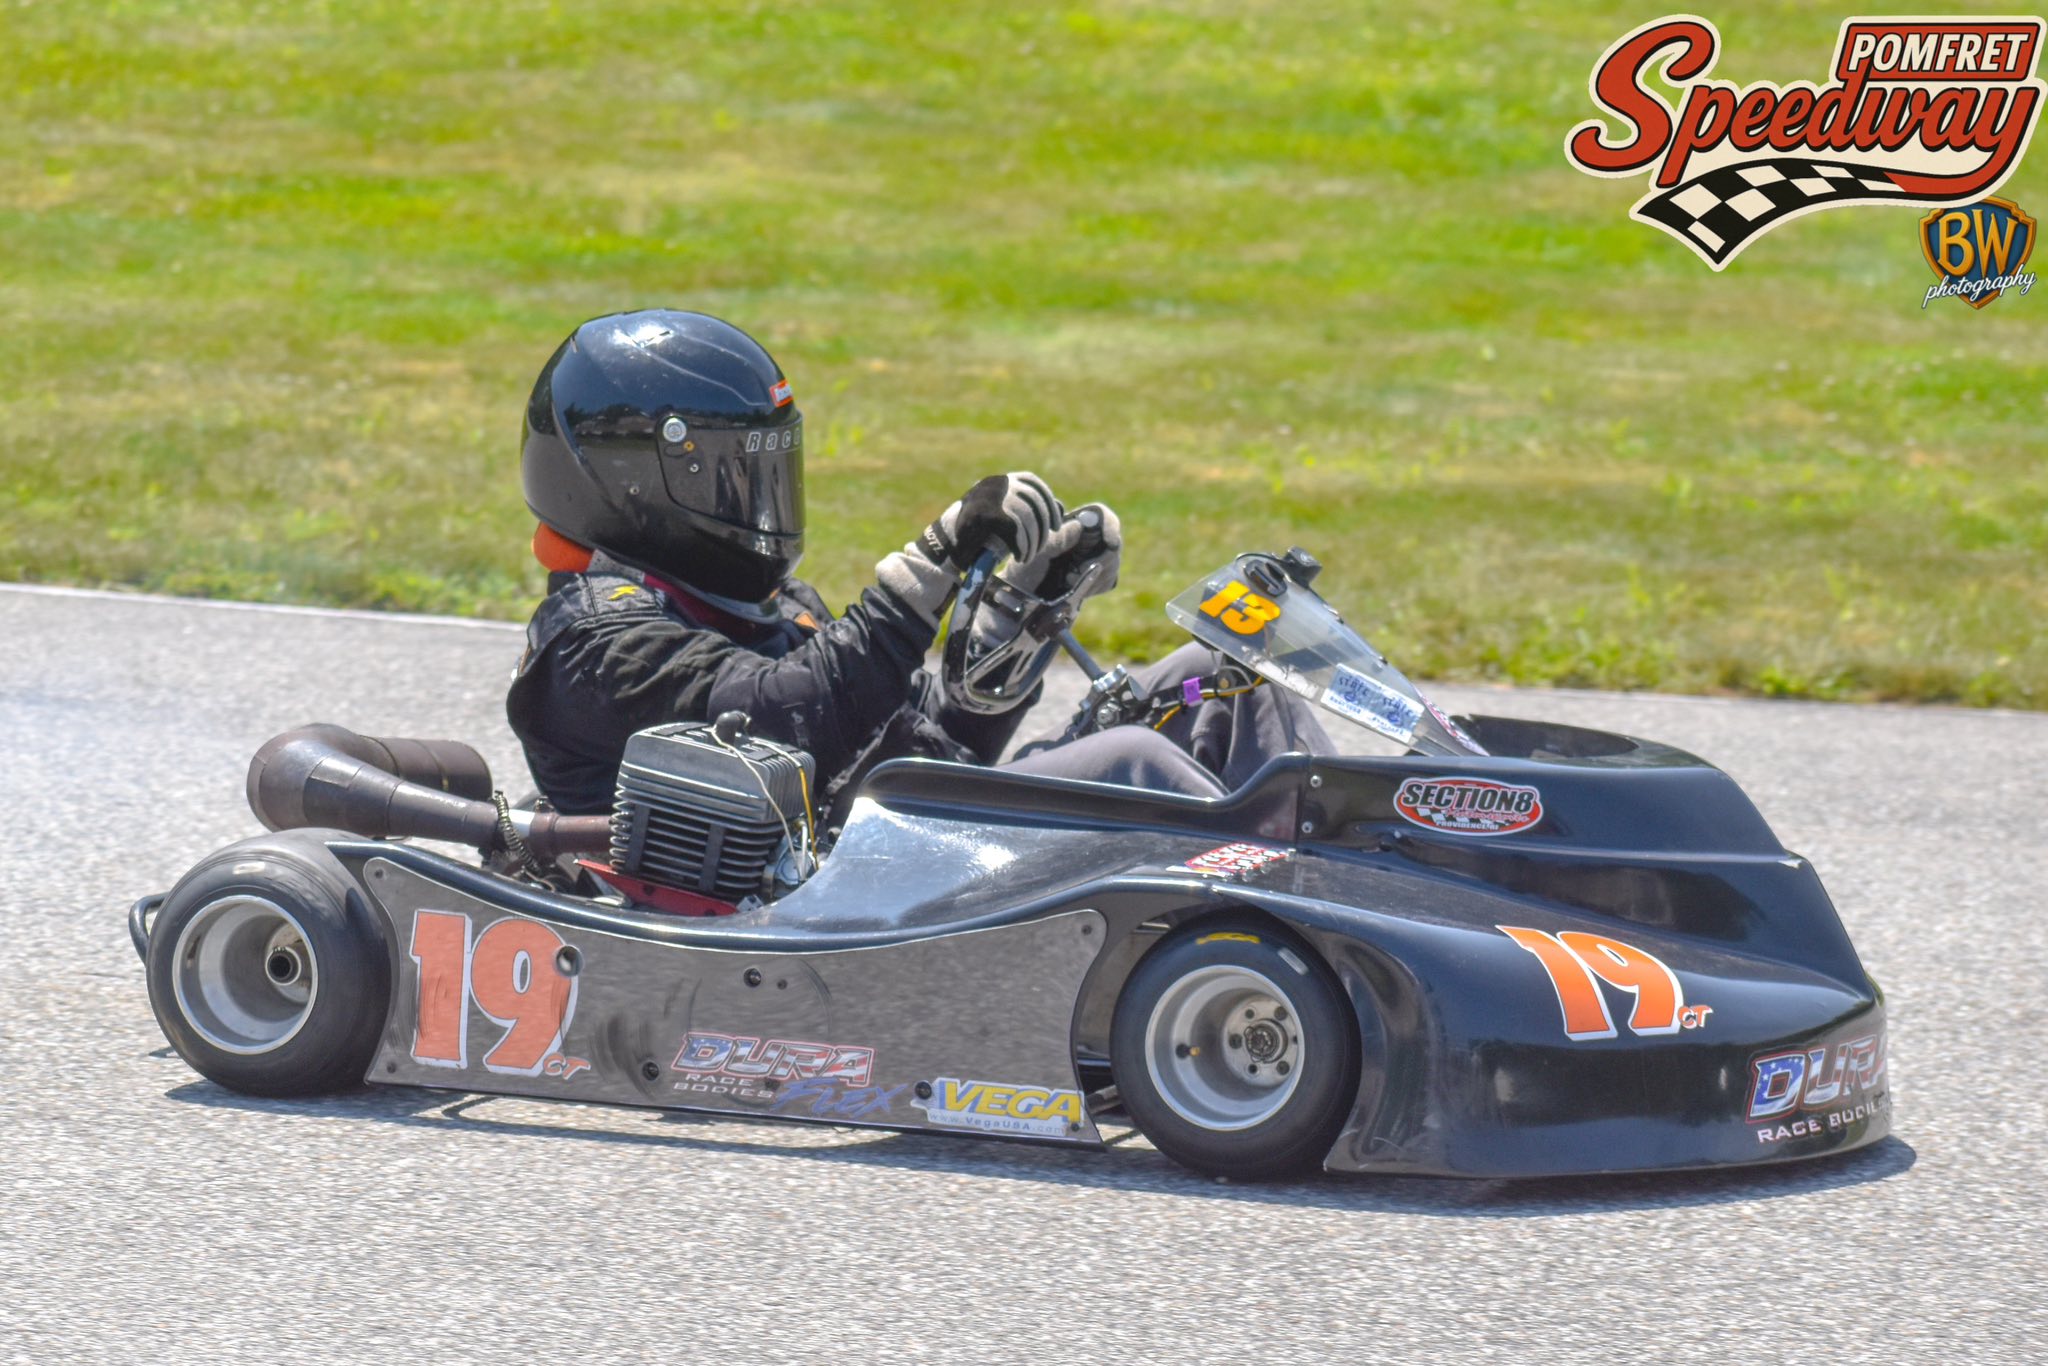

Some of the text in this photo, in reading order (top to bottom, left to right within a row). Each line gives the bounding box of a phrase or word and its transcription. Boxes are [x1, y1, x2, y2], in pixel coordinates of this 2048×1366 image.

[1200, 580, 1281, 635] 13
[1402, 783, 1534, 813] SECTION8
[409, 909, 591, 1080] 19 CT
[1495, 925, 1713, 1041] 19 CT
[671, 1032, 875, 1087] DURA
[685, 1073, 754, 1087] RACE
[1746, 1033, 1888, 1124] DUR
[673, 1082, 774, 1099] BODIES
[938, 1080, 1082, 1124] VEGA
[1757, 1119, 1822, 1142] RACE
